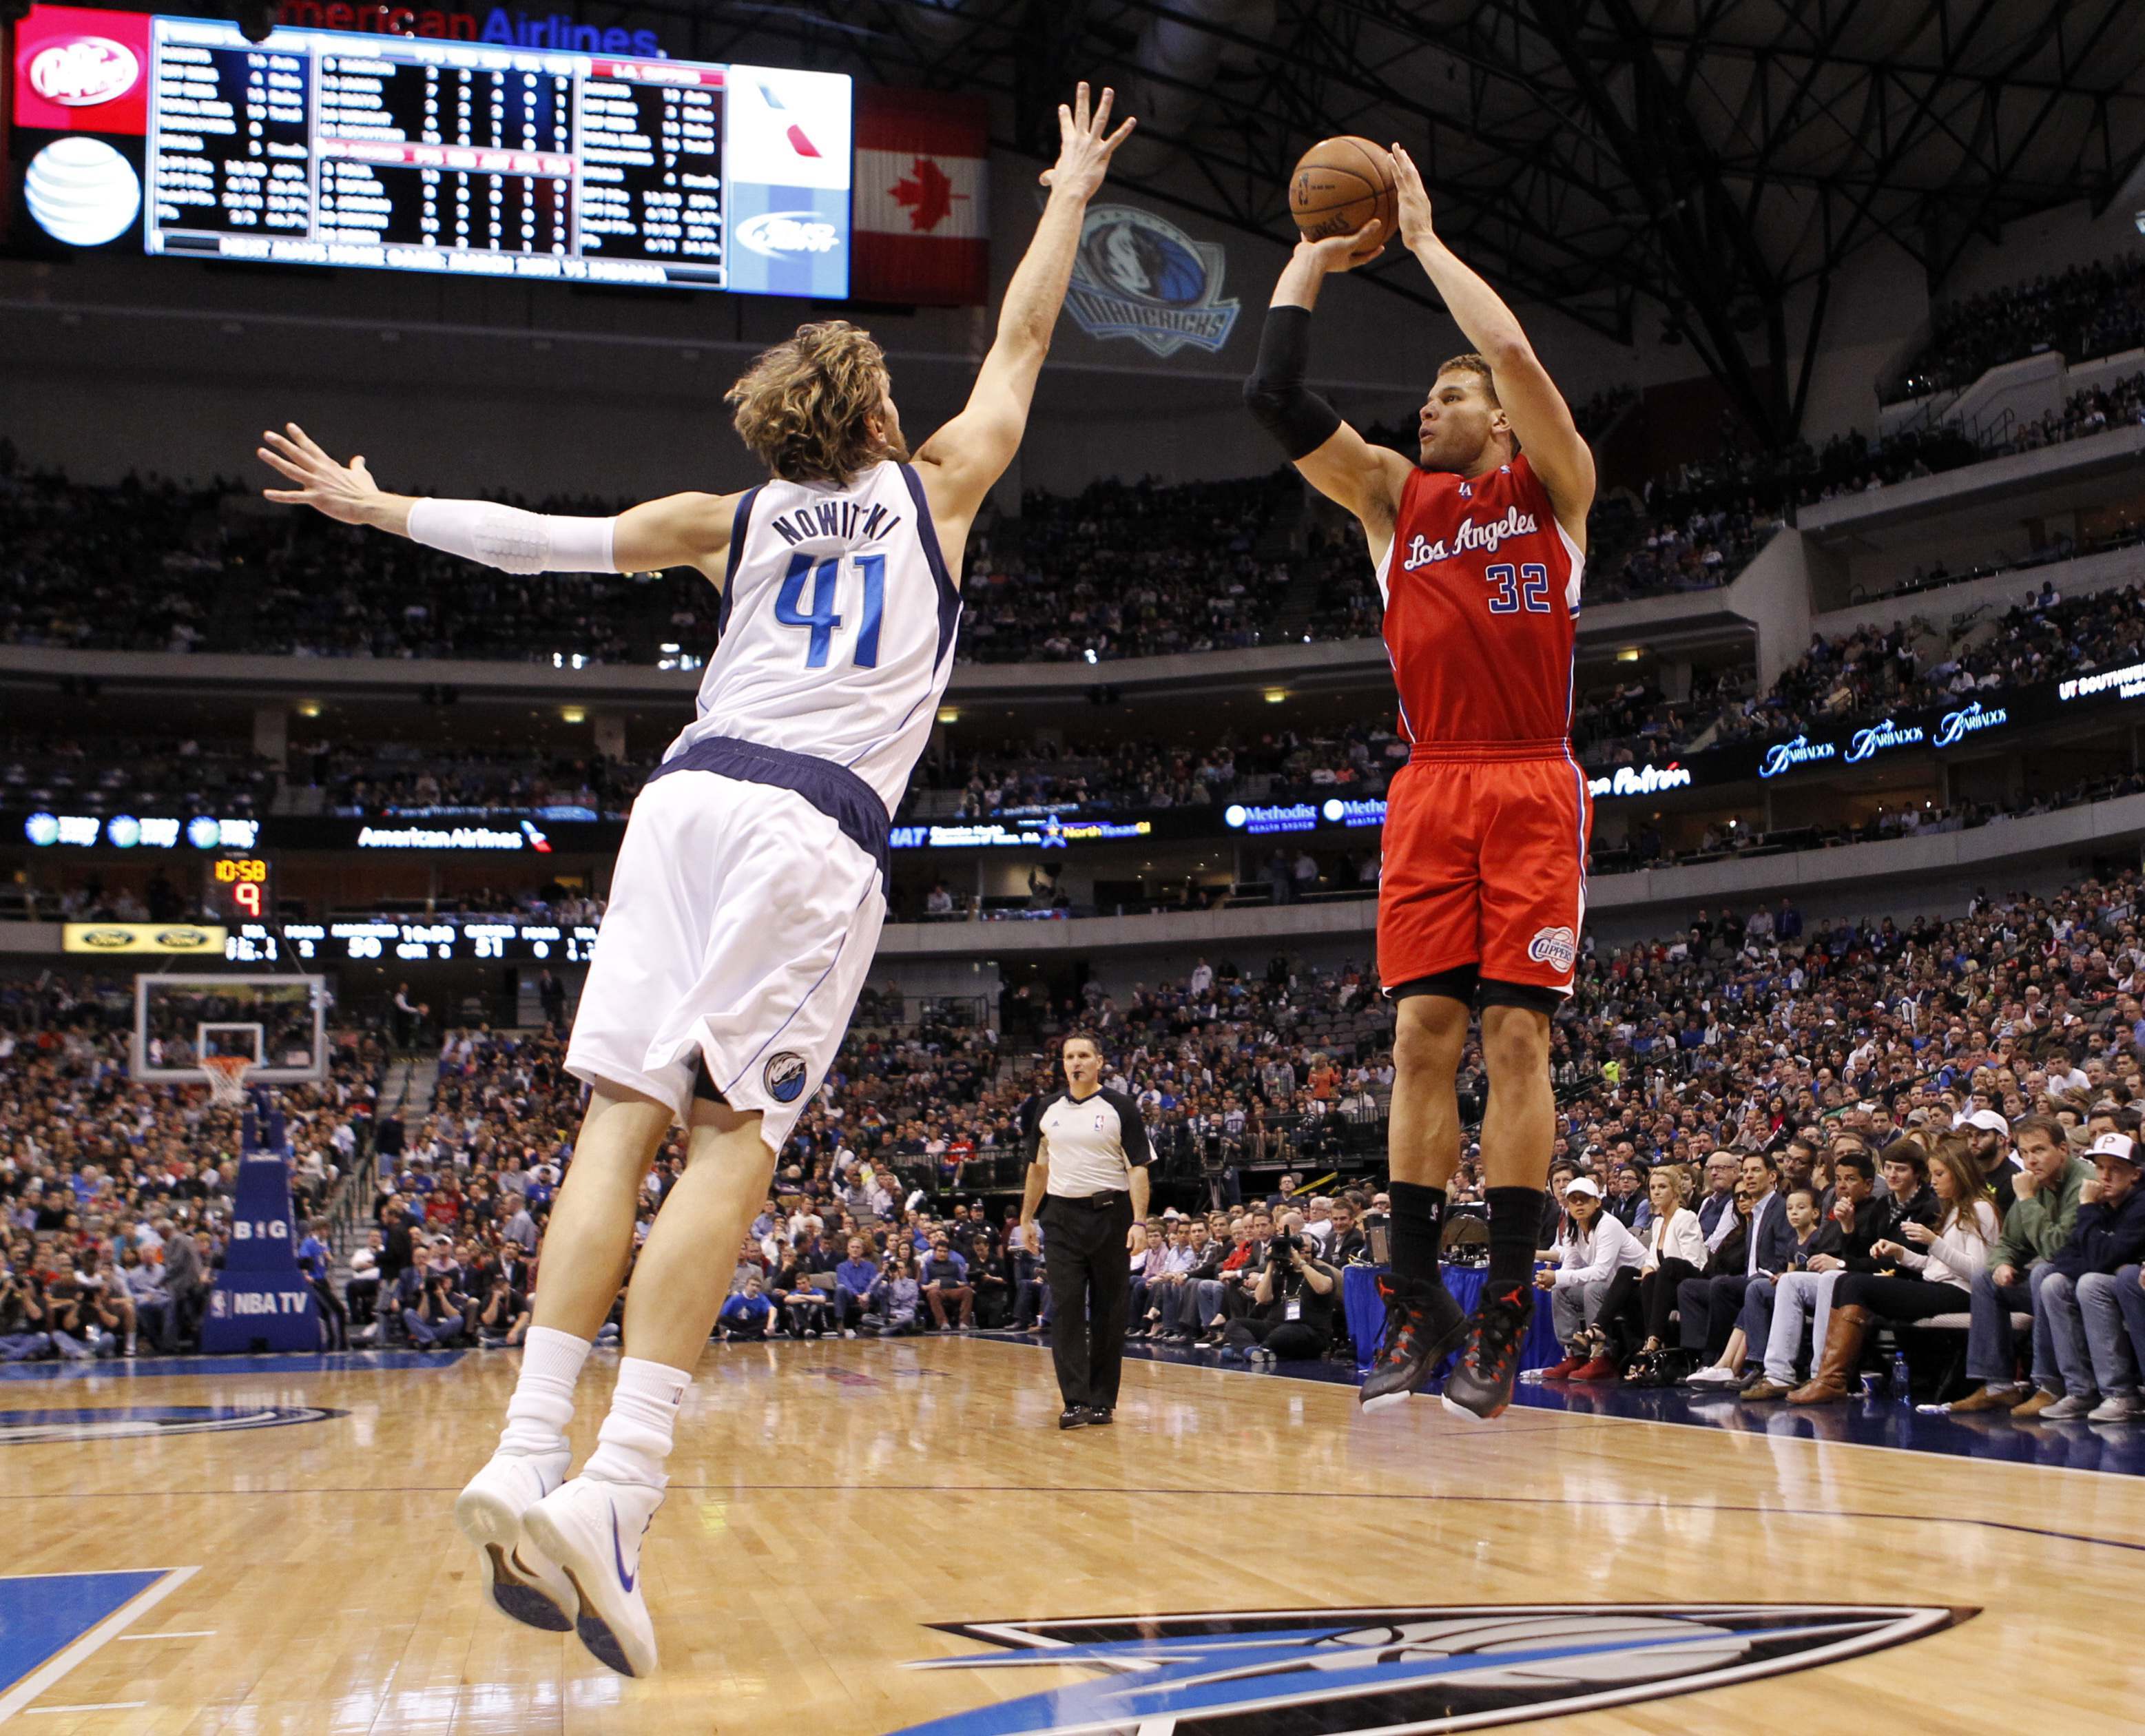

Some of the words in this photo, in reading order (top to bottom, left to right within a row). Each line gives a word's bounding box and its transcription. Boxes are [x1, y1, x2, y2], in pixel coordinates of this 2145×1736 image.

[277, 0, 478, 40] merican
[483, 7, 658, 56] Airlines
[771, 502, 902, 546] NOWITKI
[1404, 535, 1449, 571] Los
[1452, 506, 1538, 552] Angeles
[1485, 563, 1551, 613] 32
[775, 552, 888, 669] 41
[1845, 725, 1923, 763] BARBADOS
[1932, 708, 2007, 748] BARBADOS
[1759, 742, 1836, 778] BARBADOS
[1245, 805, 1316, 821] Methodist
[1345, 799, 1387, 814] Metho
[358, 827, 450, 847] American
[450, 827, 523, 848] Airlines
[215, 859, 267, 882] 10:58
[234, 882, 261, 917] 9
[2102, 1136, 2116, 1149] P
[234, 1292, 278, 1314] NBA
[279, 1292, 308, 1314] TV
